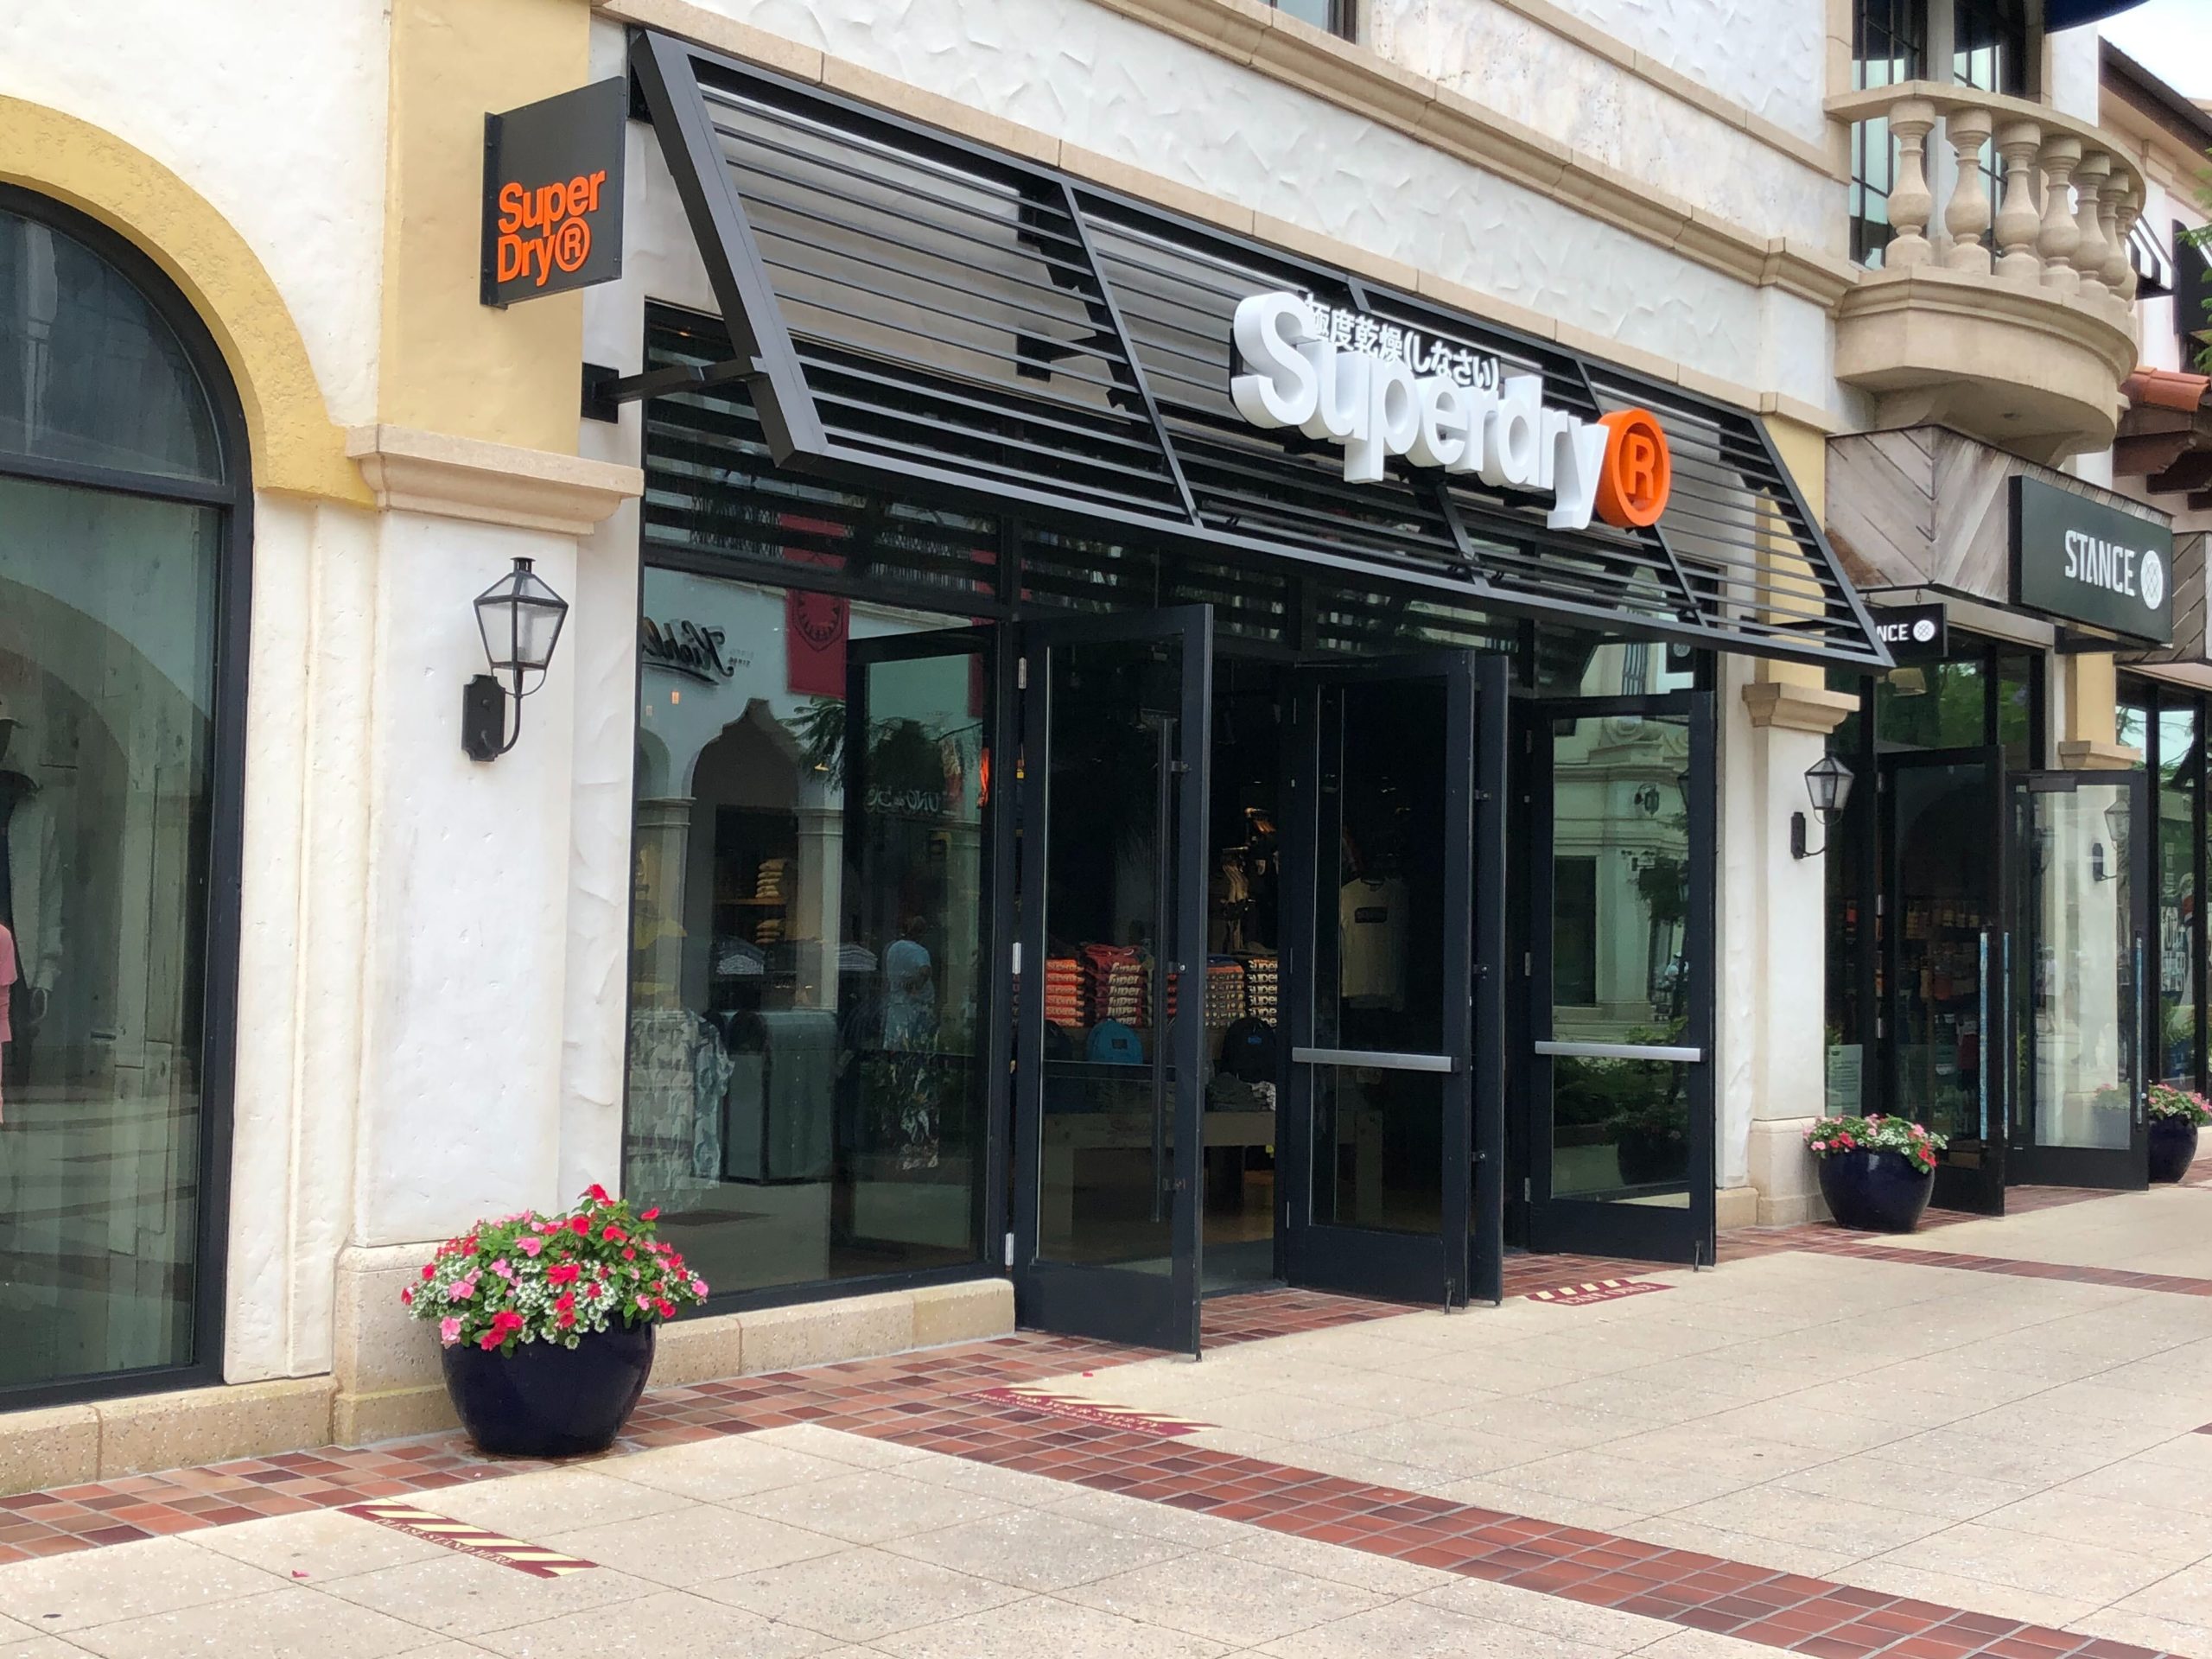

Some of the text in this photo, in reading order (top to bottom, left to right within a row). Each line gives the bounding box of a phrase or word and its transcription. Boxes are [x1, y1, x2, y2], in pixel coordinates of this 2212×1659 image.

[498, 169, 607, 238] Super
[2065, 530, 2136, 596] STANCE
[1876, 623, 1910, 642] NCE
[374, 1518, 517, 1565] PLEASE STAND HERE
